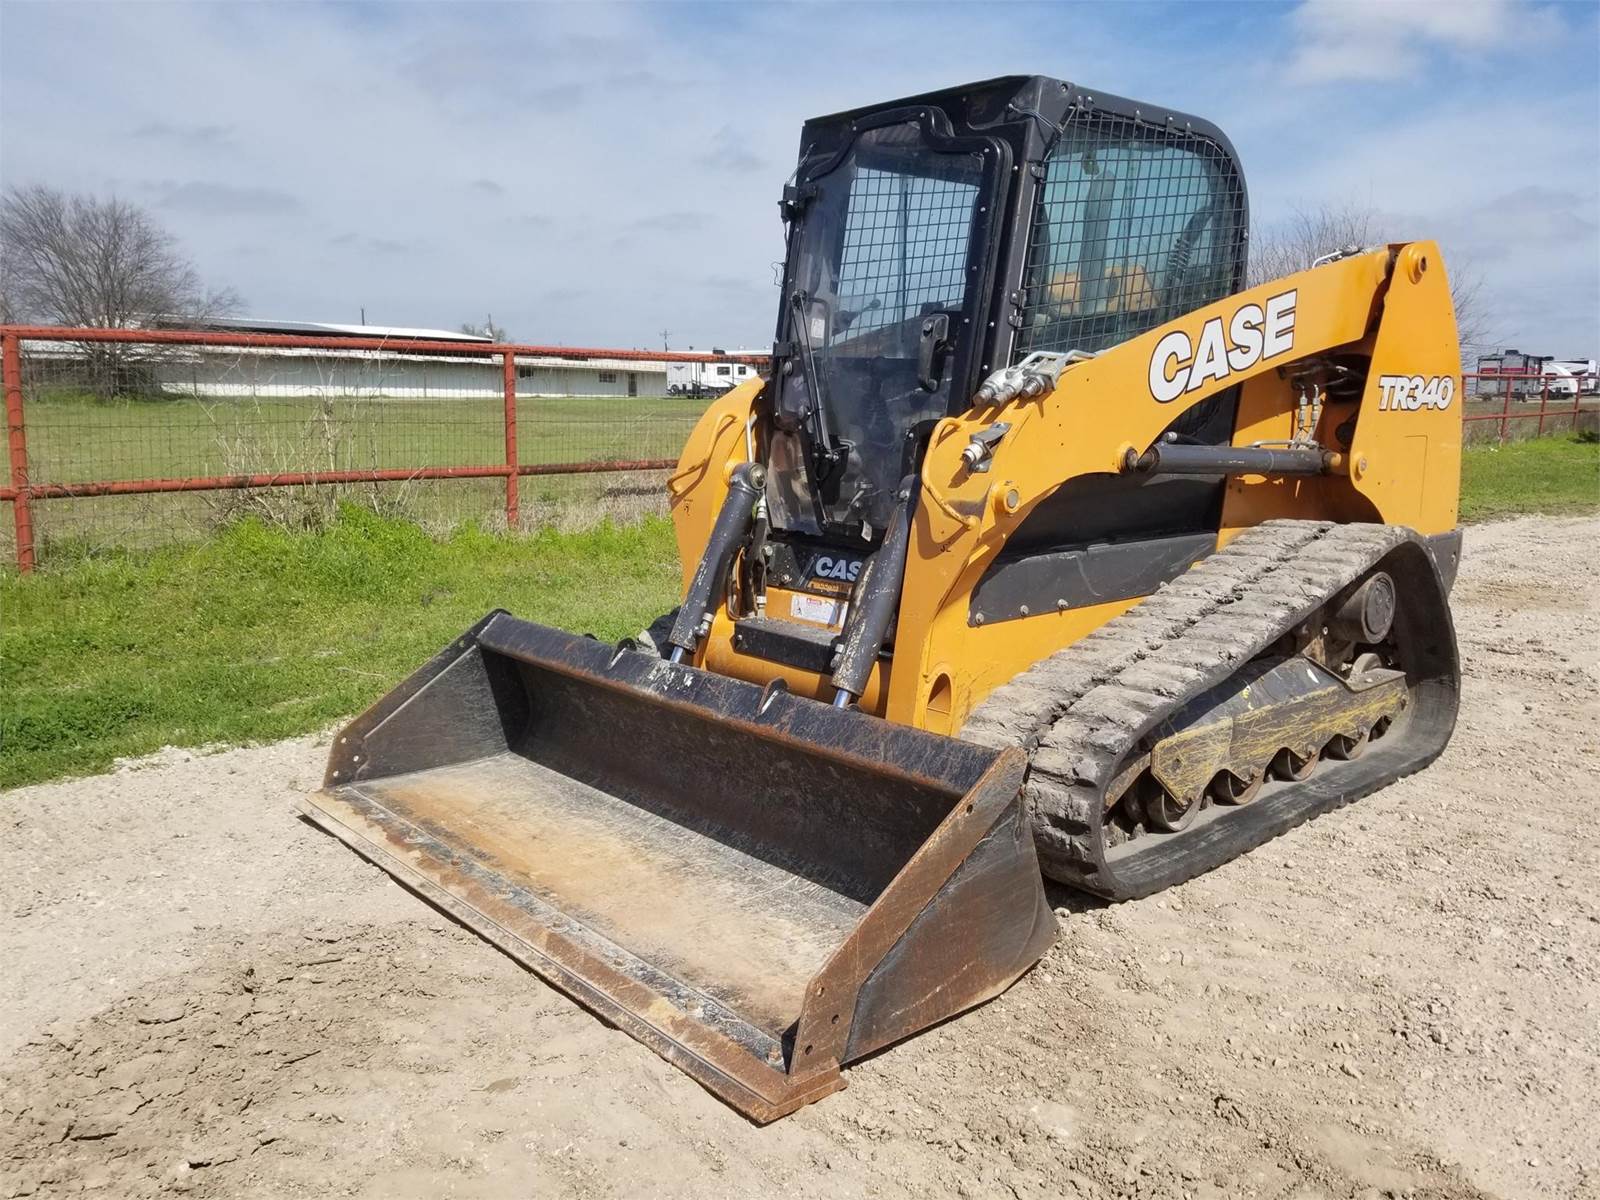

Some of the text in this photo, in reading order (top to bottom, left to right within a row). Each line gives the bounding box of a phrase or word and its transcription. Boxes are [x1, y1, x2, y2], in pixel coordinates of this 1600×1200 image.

[1148, 288, 1298, 403] CASE
[1378, 375, 1454, 412] TR340
[815, 556, 863, 582] CAS
